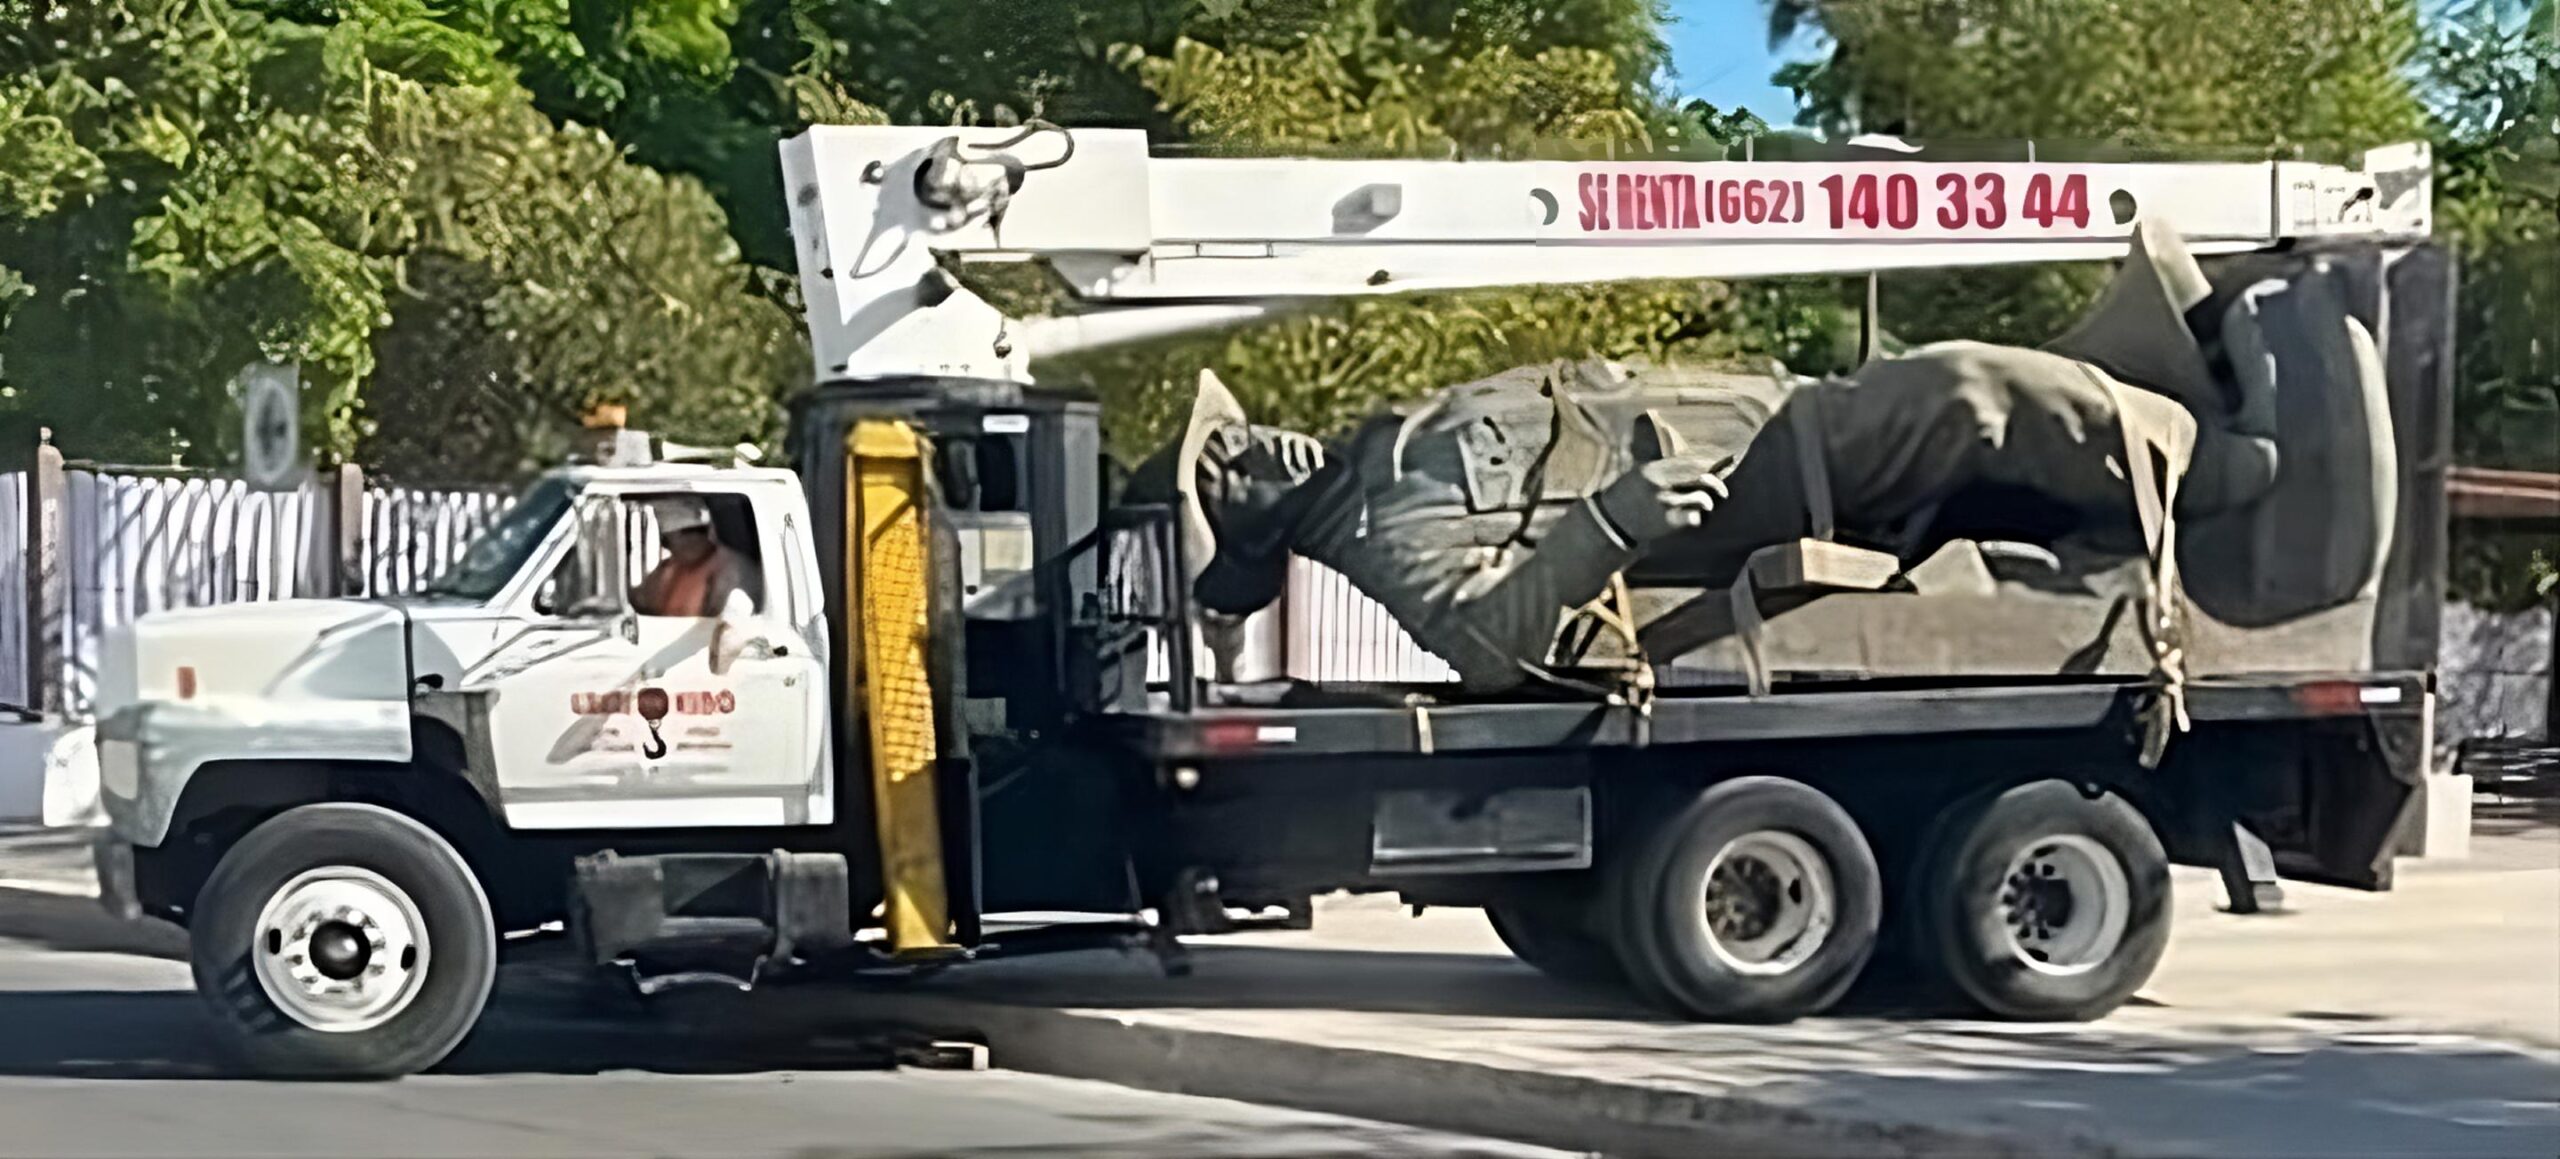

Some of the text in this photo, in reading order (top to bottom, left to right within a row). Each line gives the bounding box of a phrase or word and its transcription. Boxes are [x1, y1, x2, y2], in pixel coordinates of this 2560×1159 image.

[1705, 179, 1804, 224] (662)
[1818, 173, 1919, 230] 140
[1936, 172, 2007, 230] 33
[2022, 173, 2091, 229] 44
